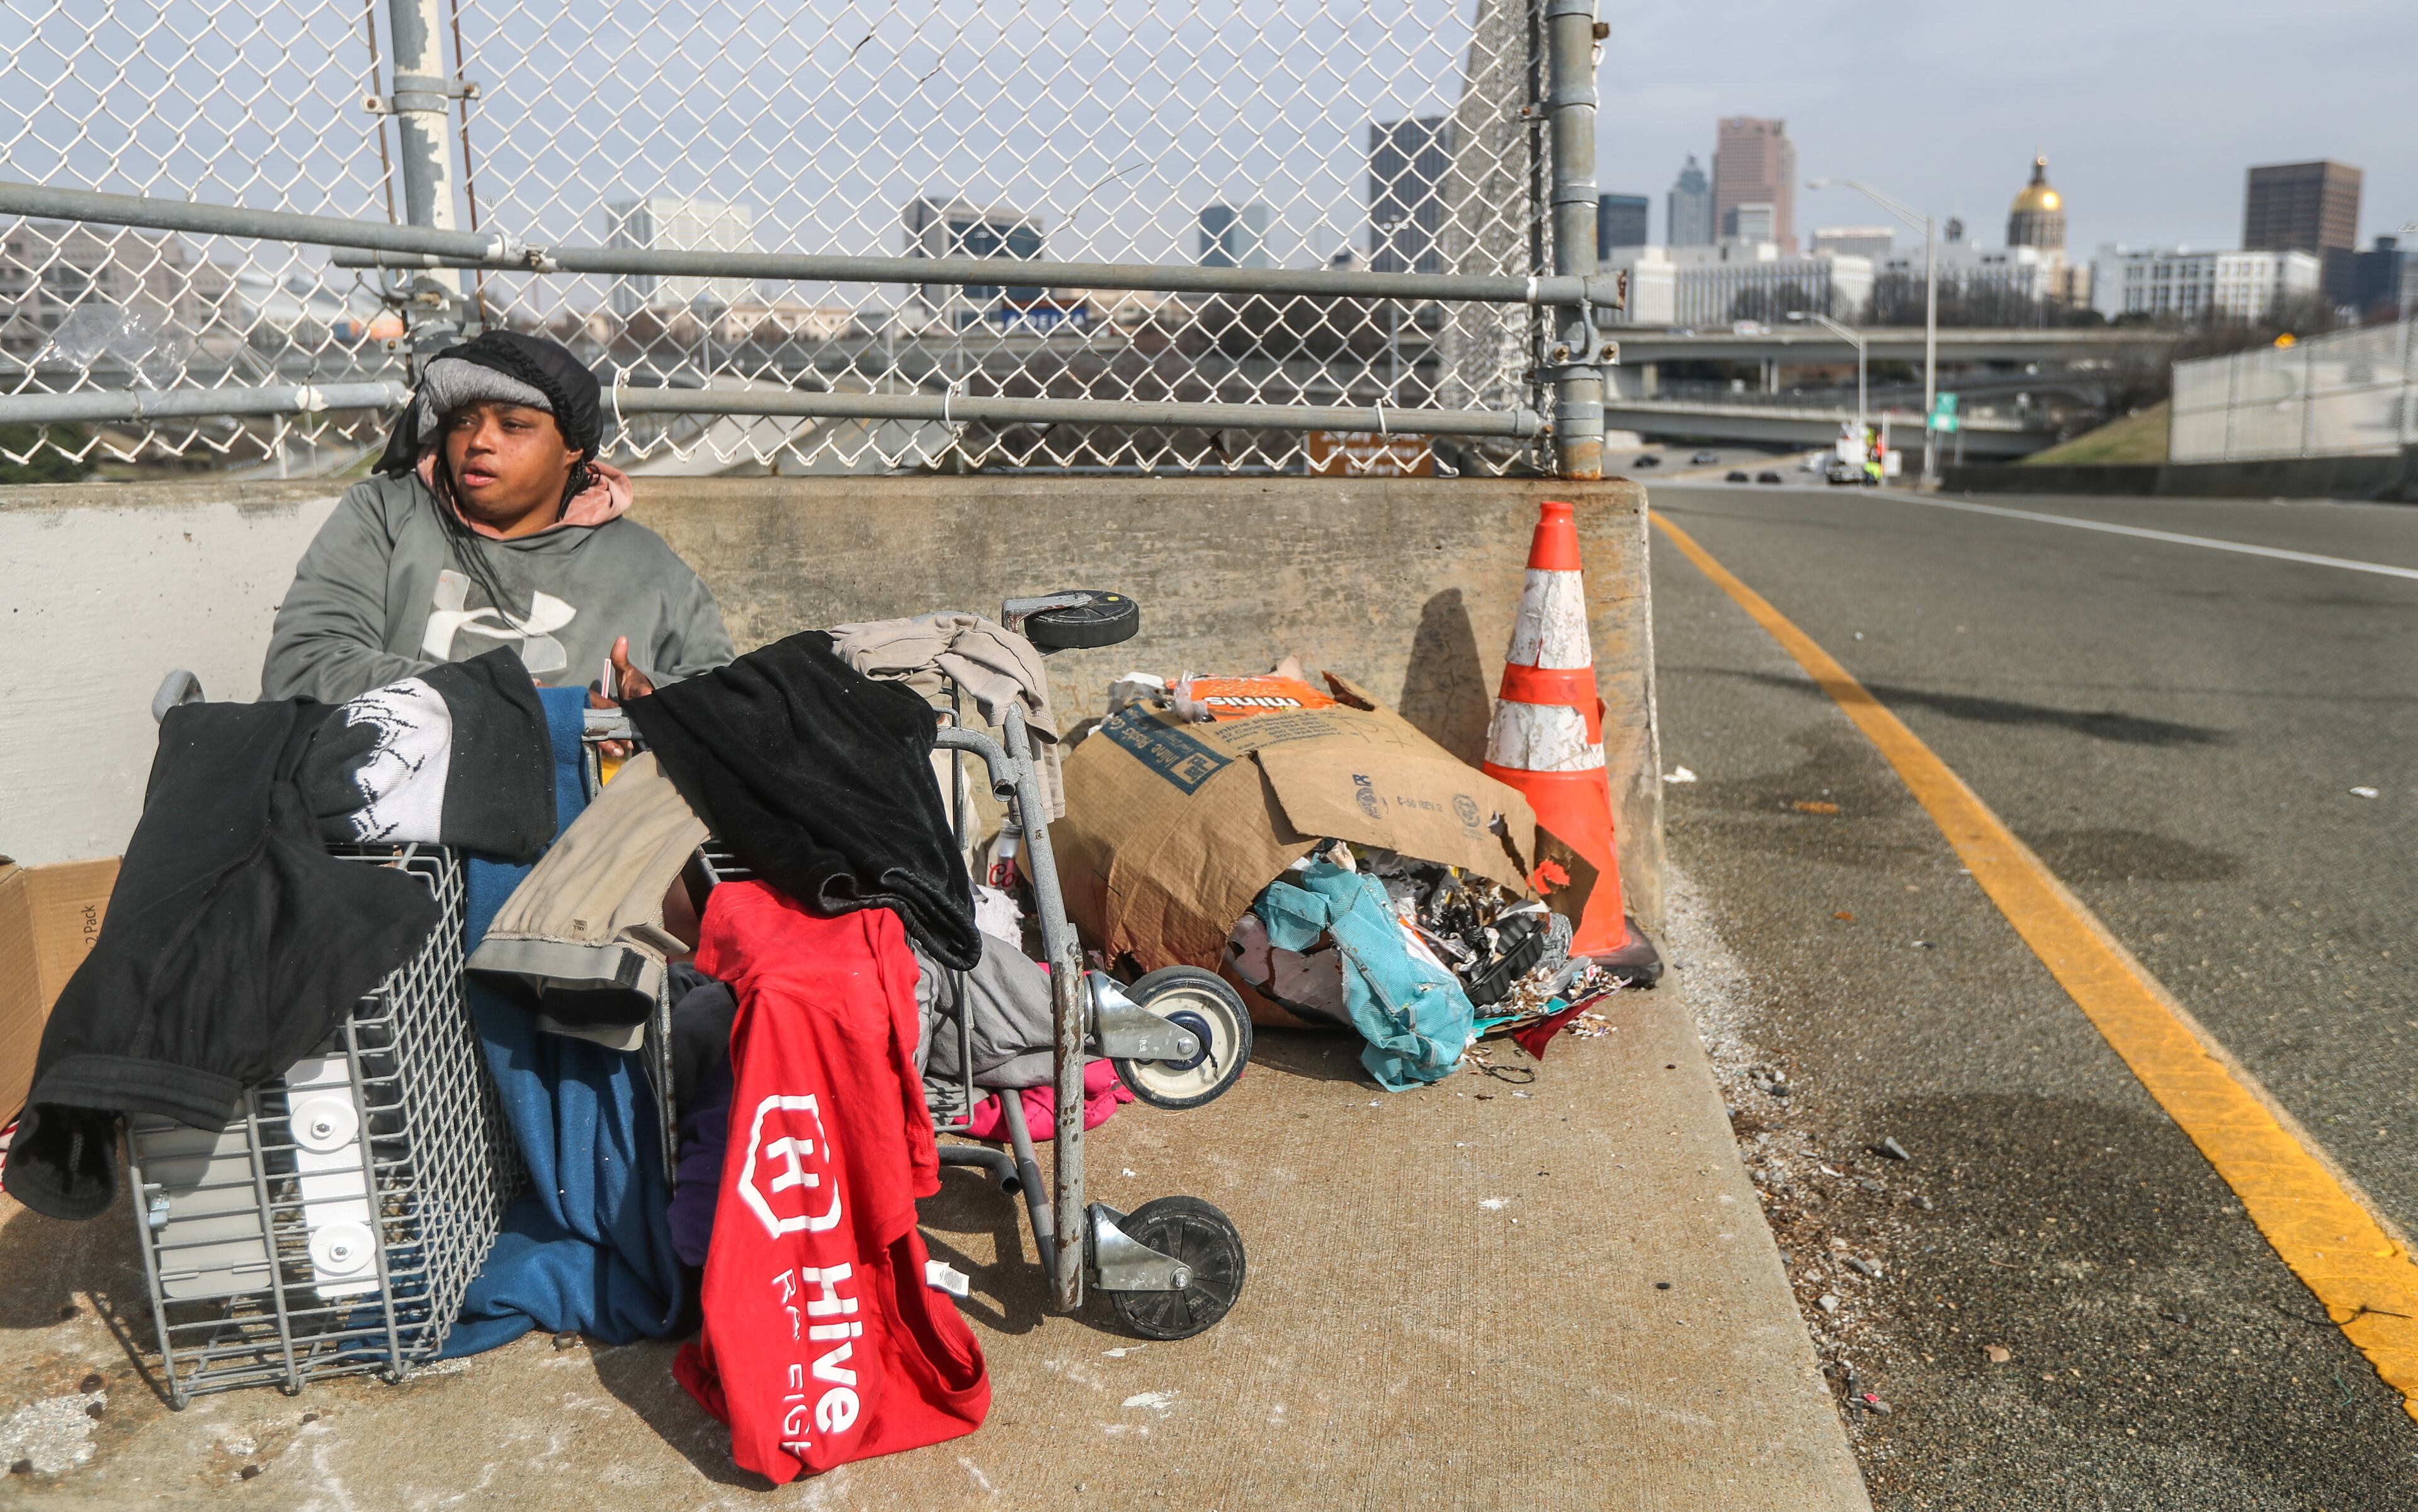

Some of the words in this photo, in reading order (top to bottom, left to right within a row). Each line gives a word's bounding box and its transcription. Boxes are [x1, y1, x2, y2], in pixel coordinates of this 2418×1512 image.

[1203, 695, 1303, 710] minis
[1150, 743, 1181, 768] Inline
[81, 904, 98, 934] Pack
[802, 1261, 864, 1433] Hive
